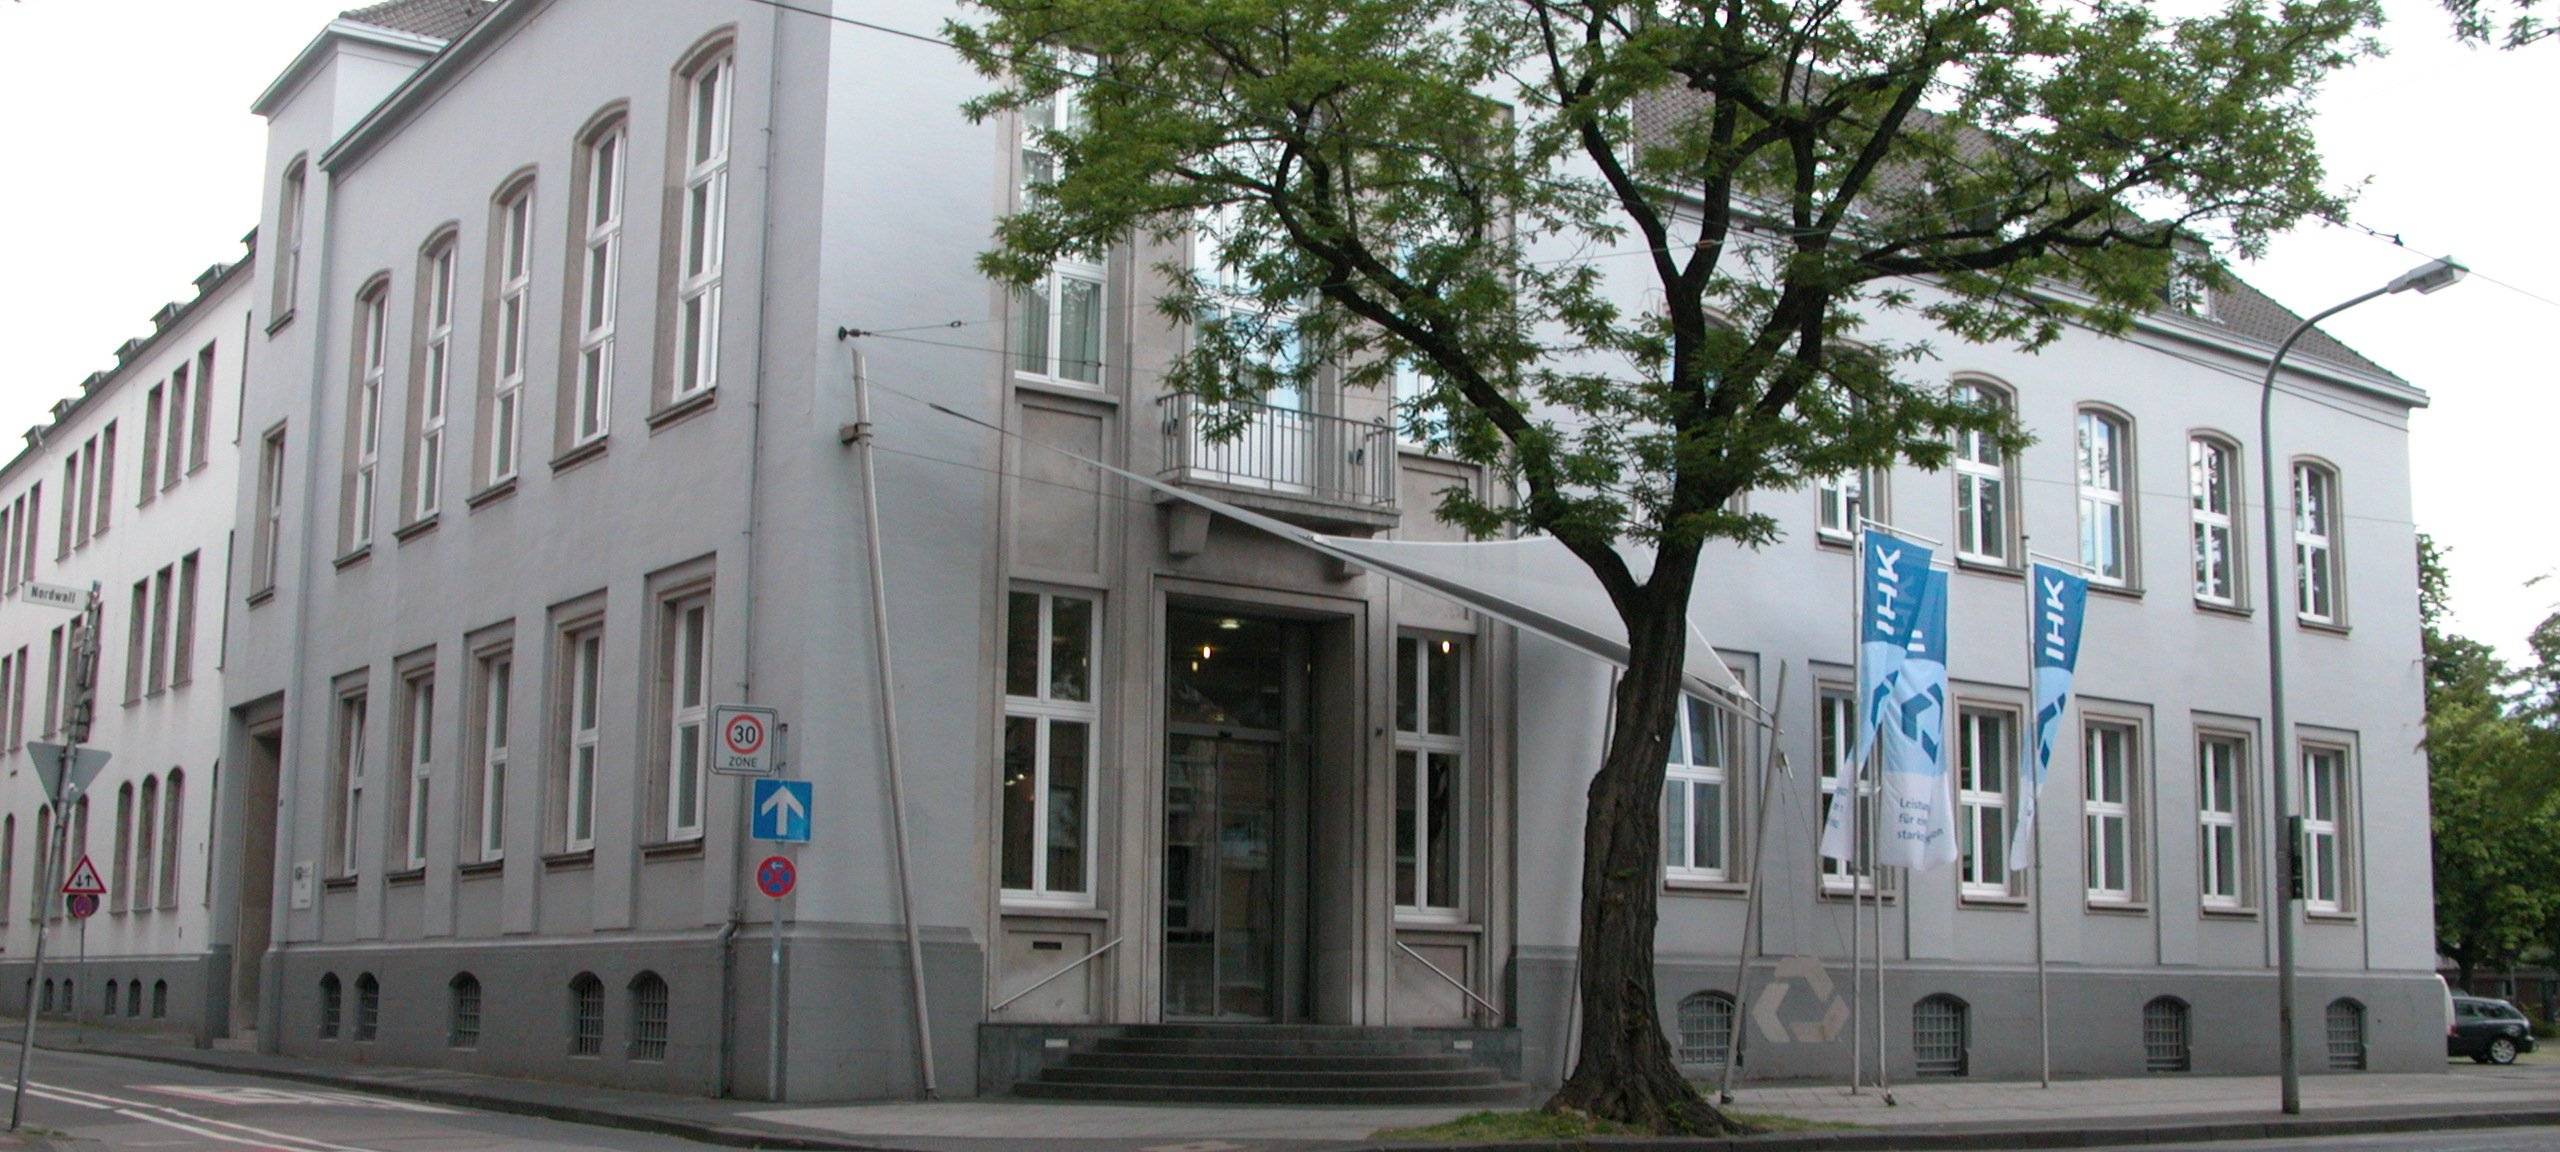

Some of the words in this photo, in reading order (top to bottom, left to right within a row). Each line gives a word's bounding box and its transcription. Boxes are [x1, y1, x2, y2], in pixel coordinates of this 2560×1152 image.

[32, 586, 75, 603] Nordwall
[1876, 545, 1900, 635] IHK
[2044, 576, 2065, 661] IHK
[733, 725, 756, 744] 30
[729, 757, 757, 768] ZONE
